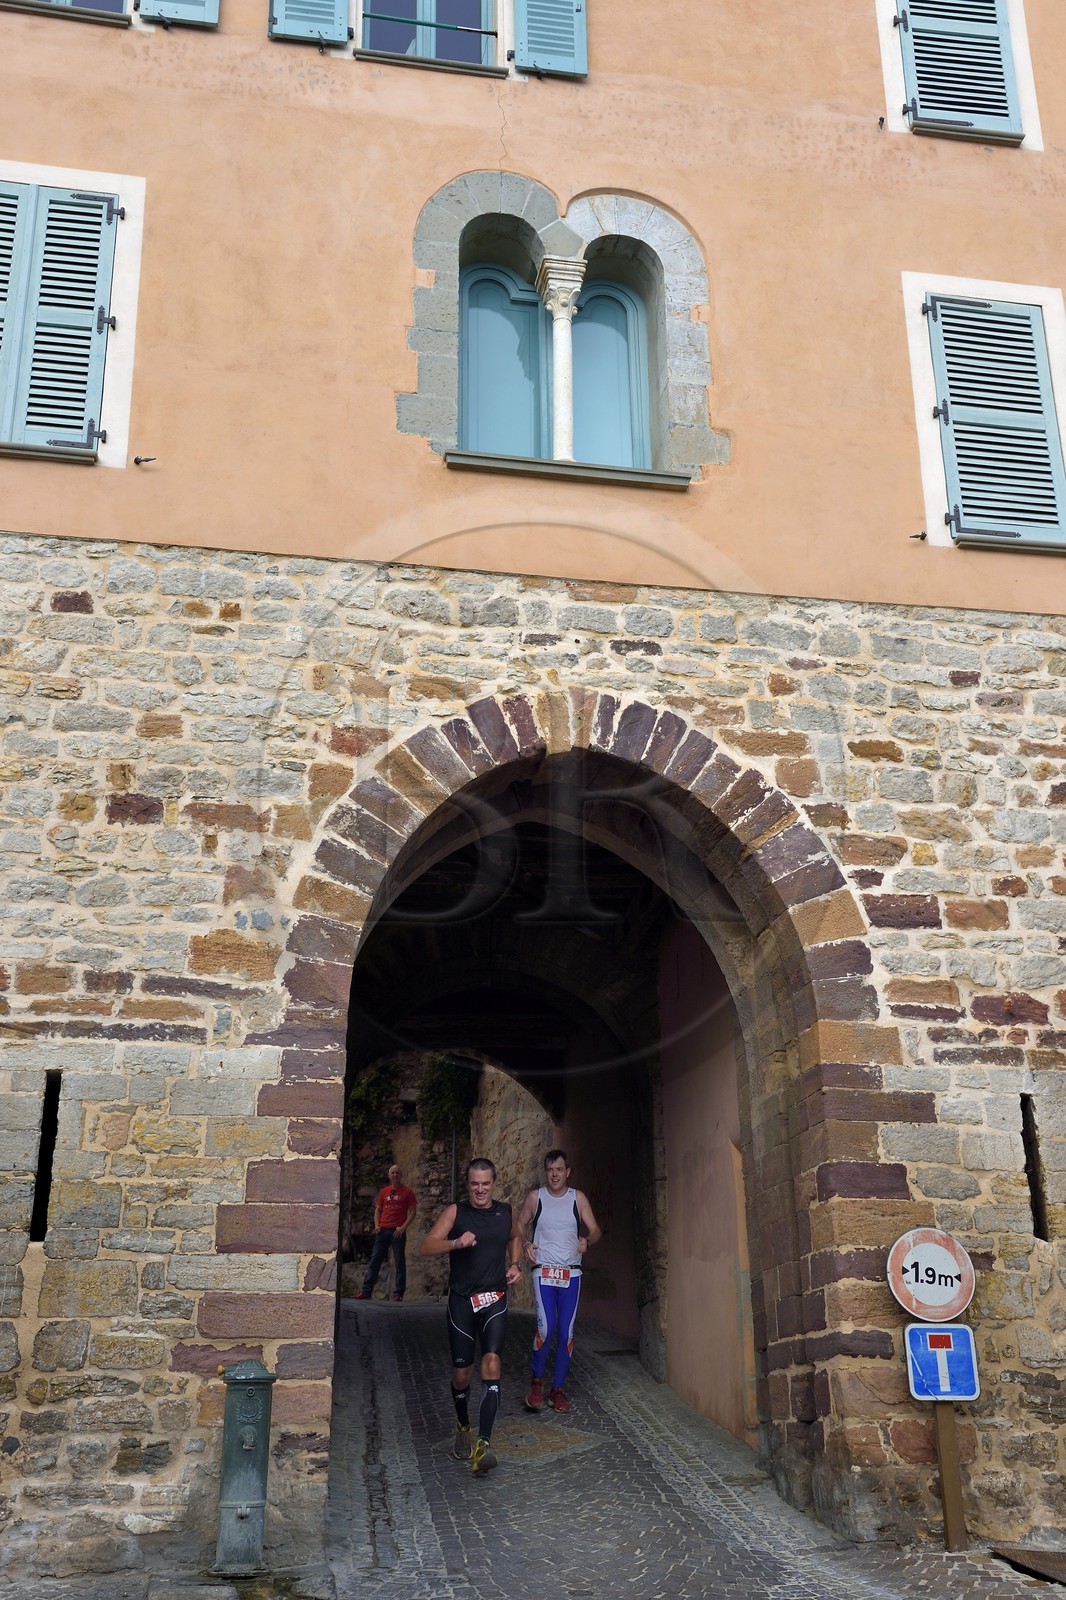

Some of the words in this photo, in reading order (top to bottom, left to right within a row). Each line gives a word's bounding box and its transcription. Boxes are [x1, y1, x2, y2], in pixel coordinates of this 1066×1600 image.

[548, 1268, 564, 1279] 441
[910, 1261, 954, 1288] 1.9m
[477, 1291, 499, 1306] 565
